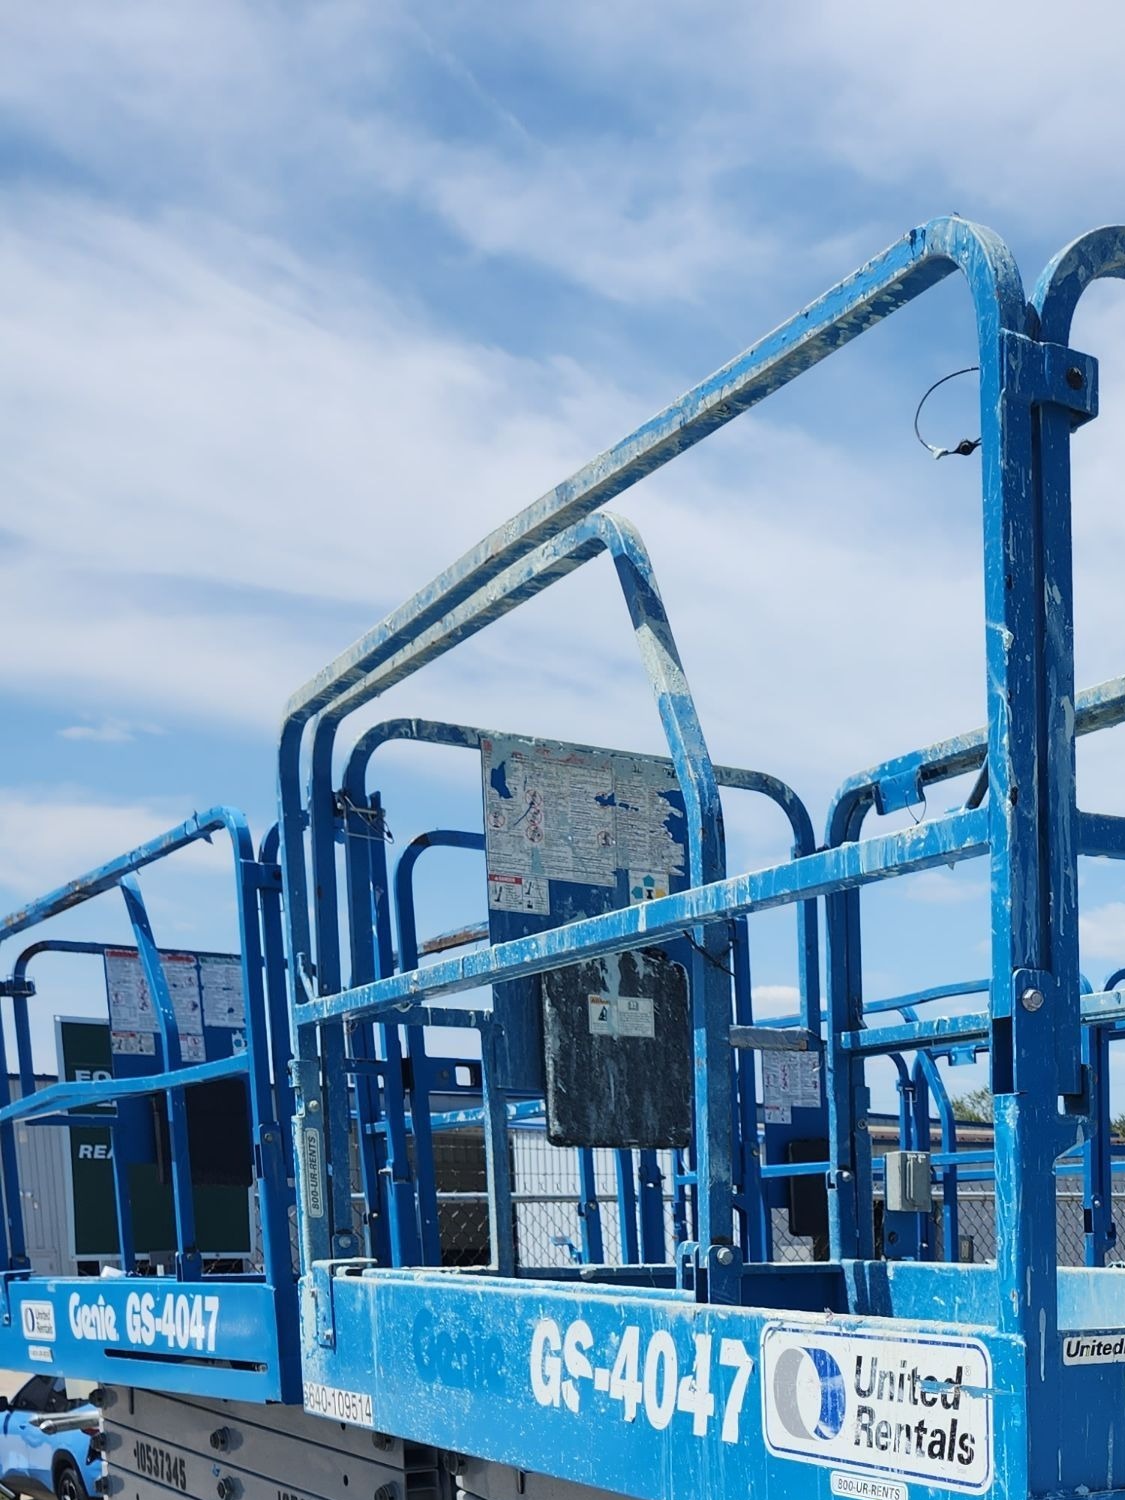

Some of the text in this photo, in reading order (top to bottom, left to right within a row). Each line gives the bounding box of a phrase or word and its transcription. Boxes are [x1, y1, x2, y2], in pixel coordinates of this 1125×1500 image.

[69, 1292, 219, 1352] Genie GS-4047
[530, 1317, 754, 1444] GS-4047
[853, 1355, 964, 1411] United
[853, 1405, 976, 1466] Rentals
[136, 1440, 187, 1490] 10537345
[837, 1478, 901, 1500] 800-UR-RENTS
